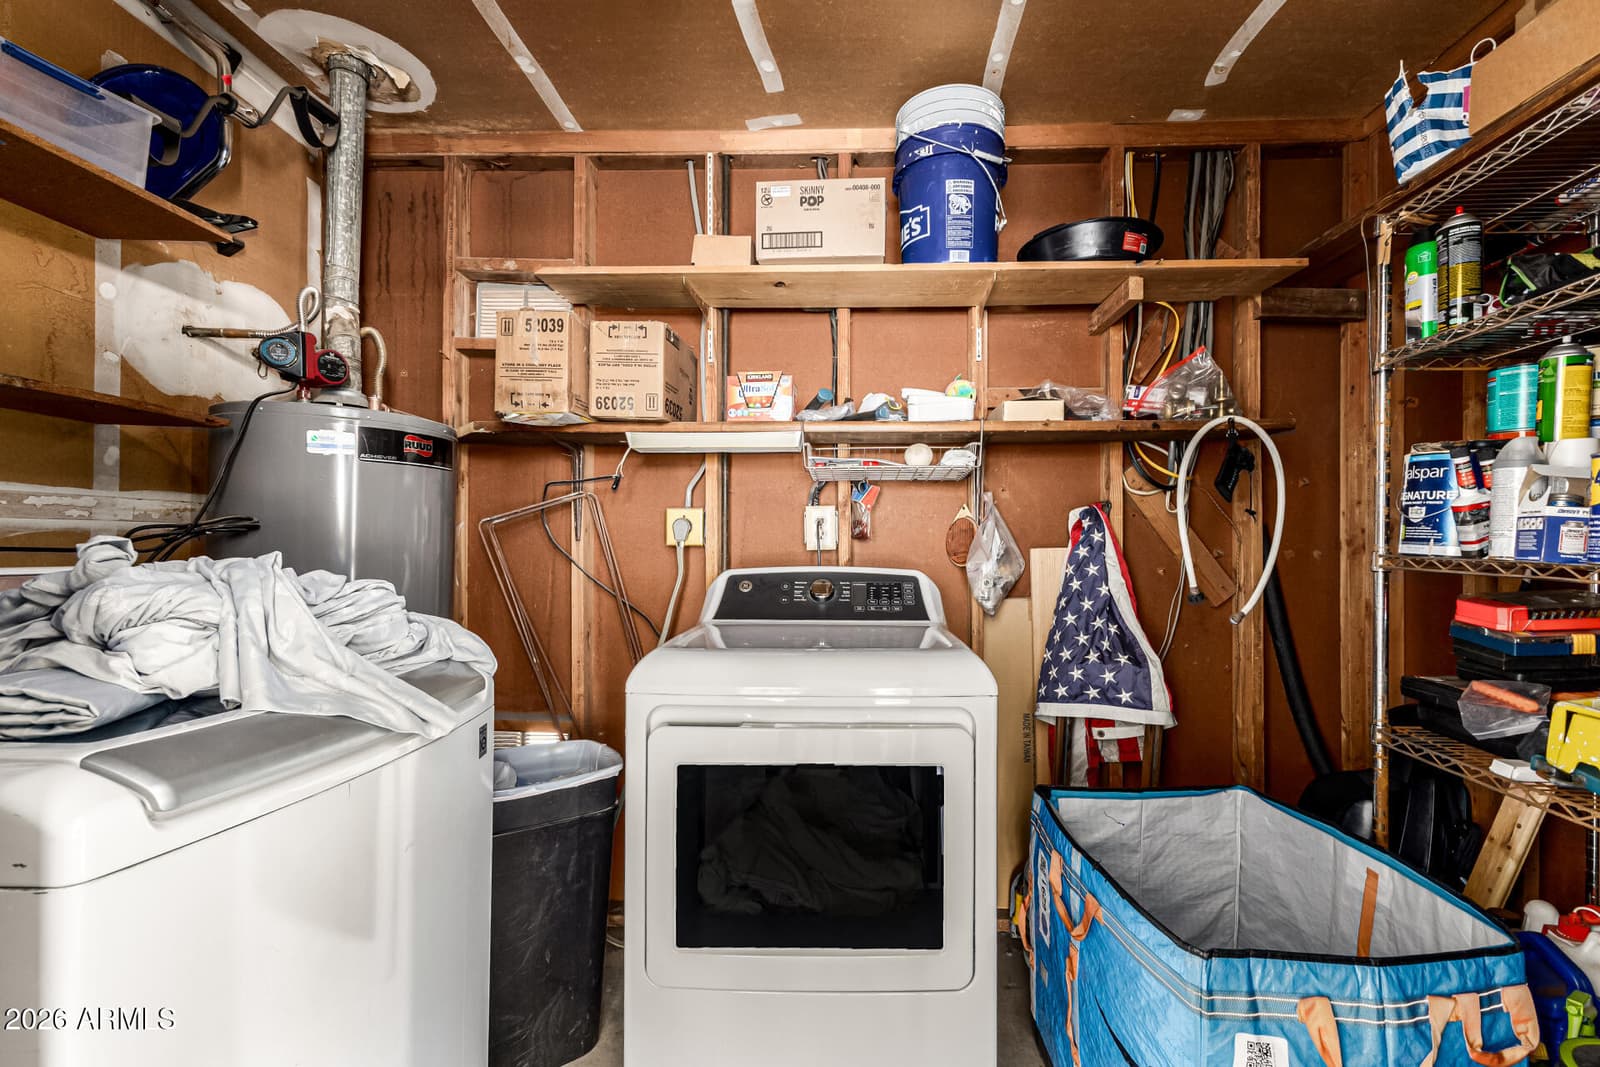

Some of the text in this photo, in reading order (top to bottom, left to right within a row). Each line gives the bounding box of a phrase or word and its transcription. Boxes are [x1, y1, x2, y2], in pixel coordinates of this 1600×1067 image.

[800, 196, 824, 207] POP
[595, 396, 634, 410] 52039
[404, 440, 433, 451] RUUD
[1406, 465, 1450, 482] alspar
[1402, 490, 1458, 500] GNATURE
[1023, 713, 1031, 731] MADE
